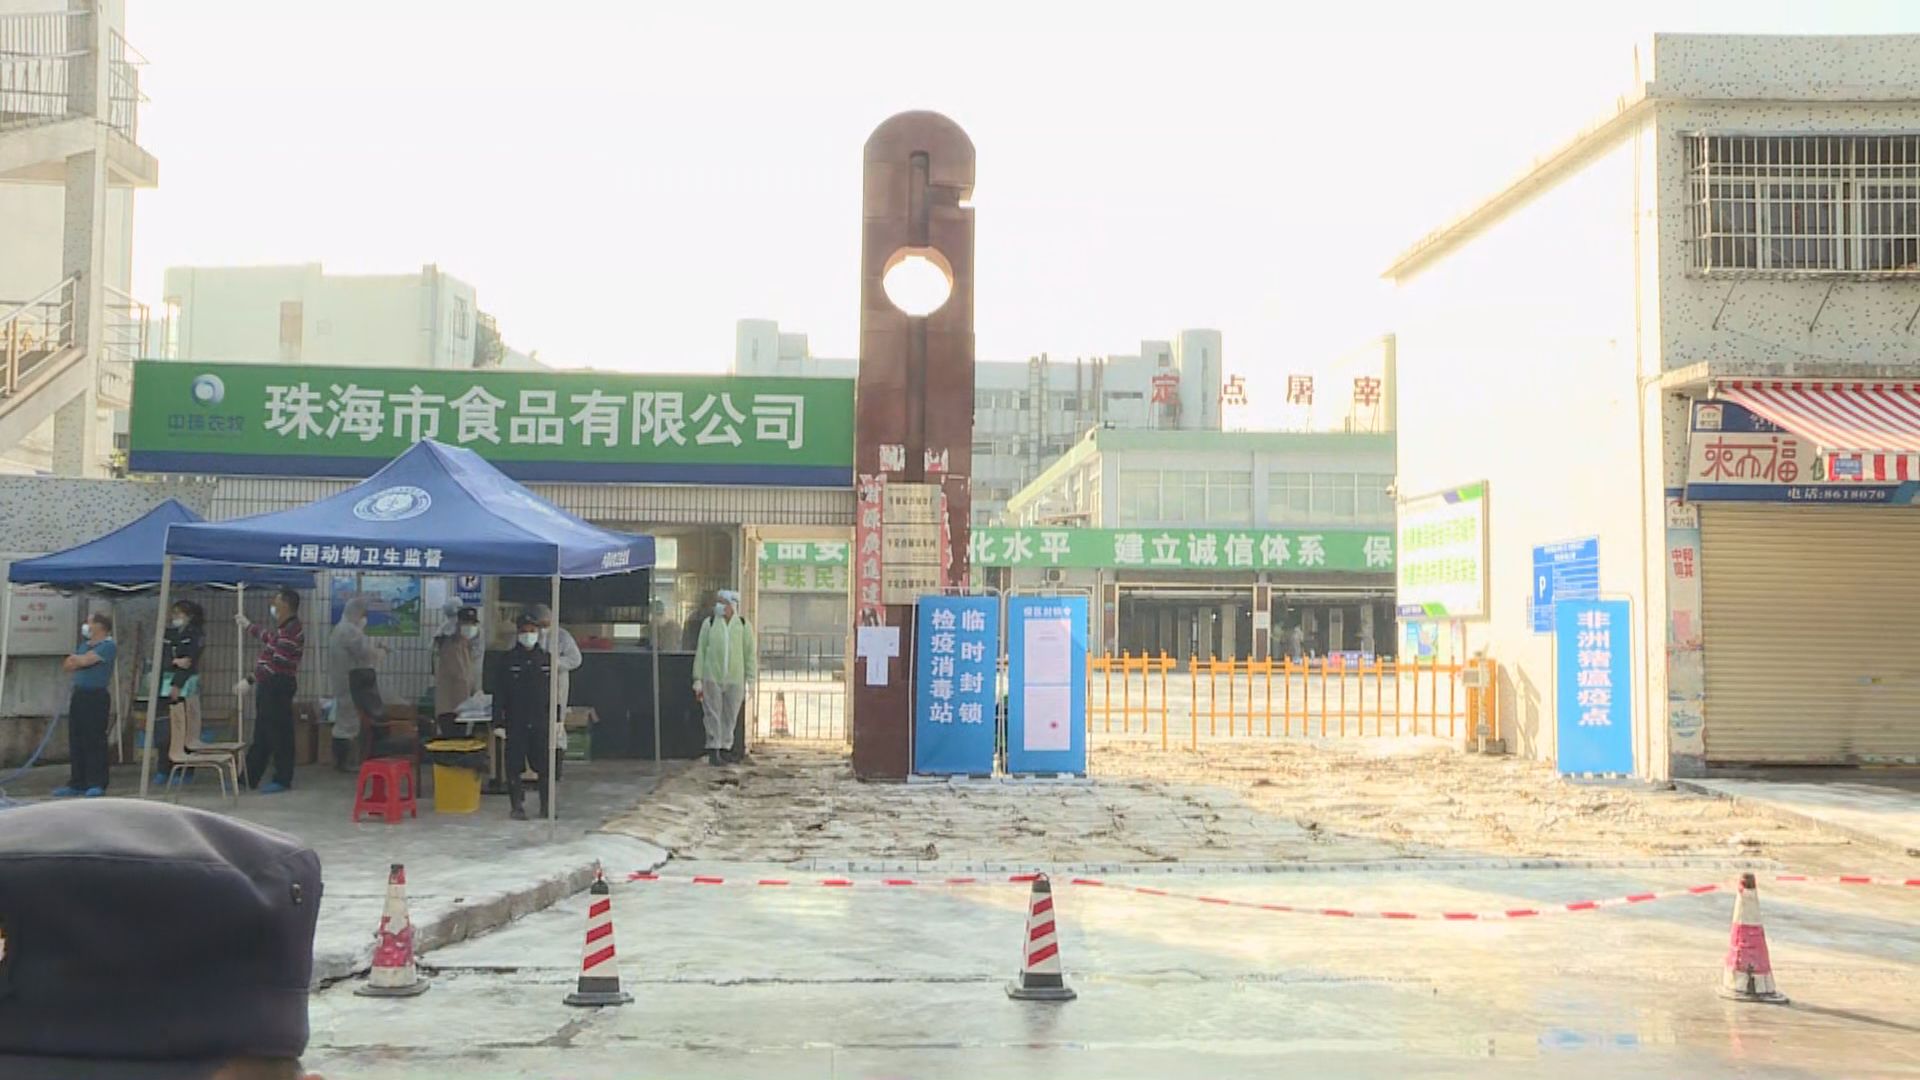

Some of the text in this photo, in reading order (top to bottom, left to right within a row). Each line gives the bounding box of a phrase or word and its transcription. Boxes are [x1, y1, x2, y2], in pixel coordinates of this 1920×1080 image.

[263, 382, 806, 450] 珠海市食品有限公司
[1152, 374, 1381, 406] 定点屠宰
[279, 544, 443, 569] 中国动物卫生监督
[969, 531, 1393, 567] 化水平 建立诚信体系 保
[928, 608, 957, 724] 检疫消毒站
[958, 608, 986, 724] 临时封锁
[1576, 609, 1612, 726] 非洲猪瘟疫点
